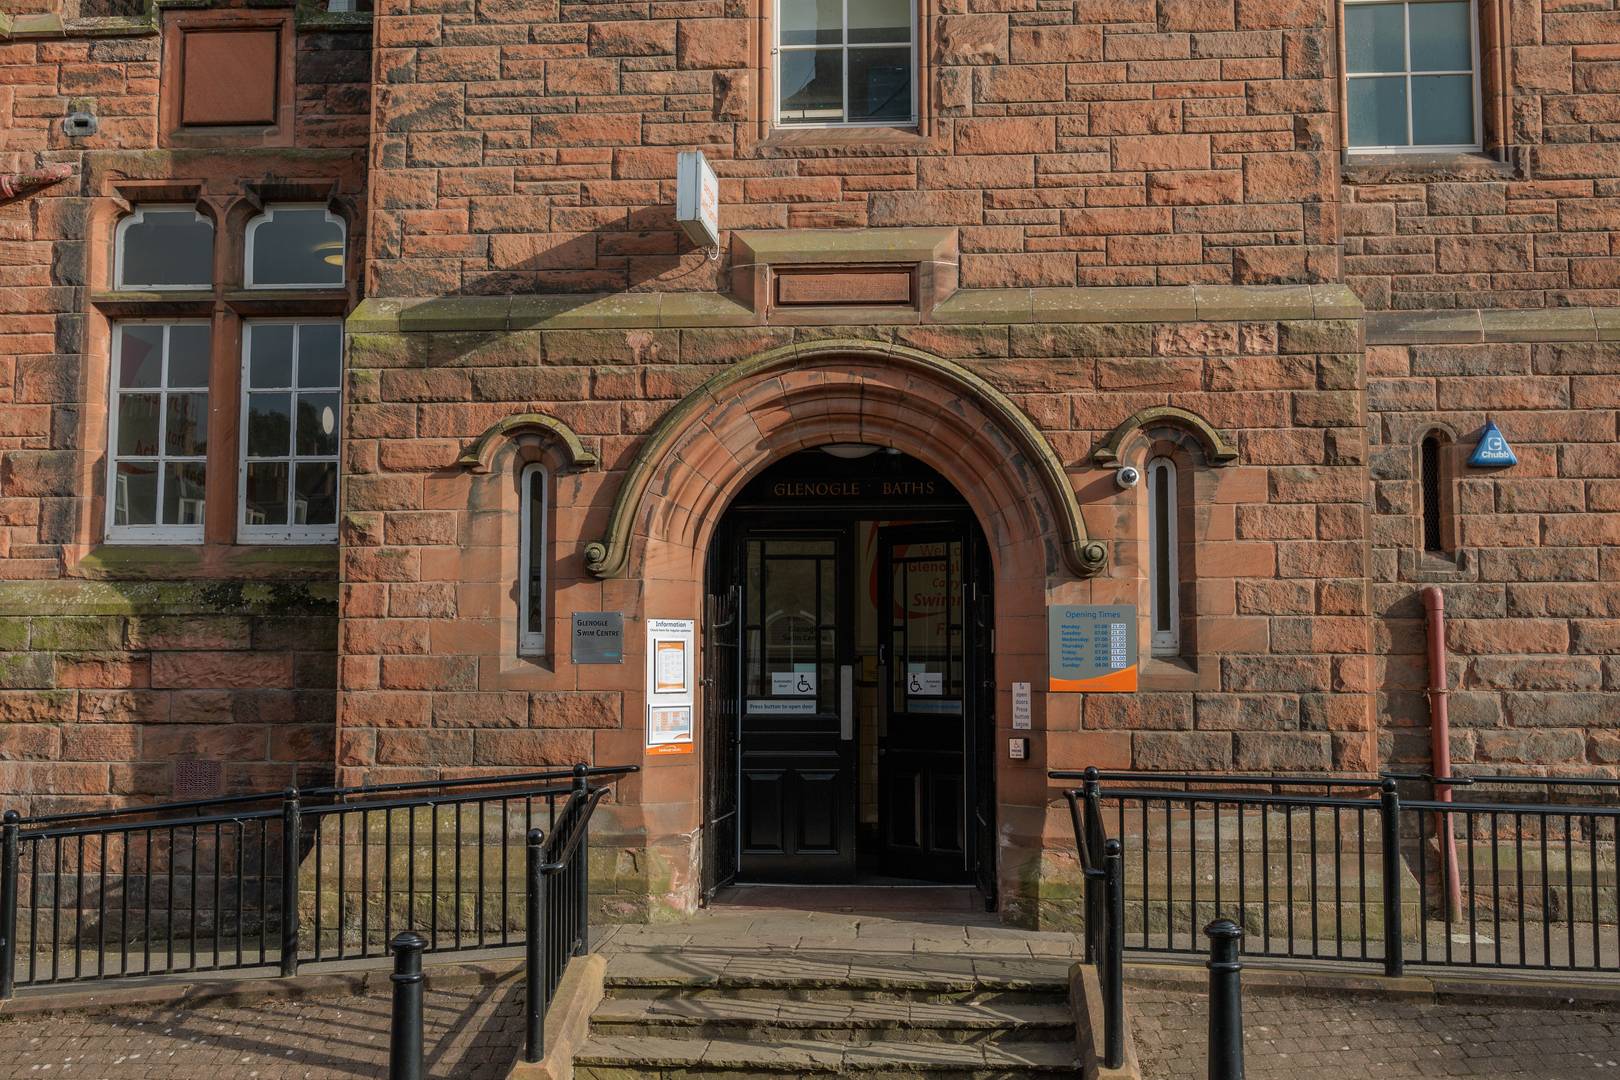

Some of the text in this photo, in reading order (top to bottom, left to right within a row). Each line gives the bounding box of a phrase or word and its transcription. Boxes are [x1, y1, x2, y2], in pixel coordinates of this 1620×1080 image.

[1481, 450, 1509, 458] Chubb
[774, 481, 935, 496] GLENOGLE BATHS
[1065, 610, 1121, 620] Opening Times
[577, 619, 609, 627] GLENOGLE
[655, 620, 687, 629] Information
[577, 629, 620, 637] SWIM CENTRE
